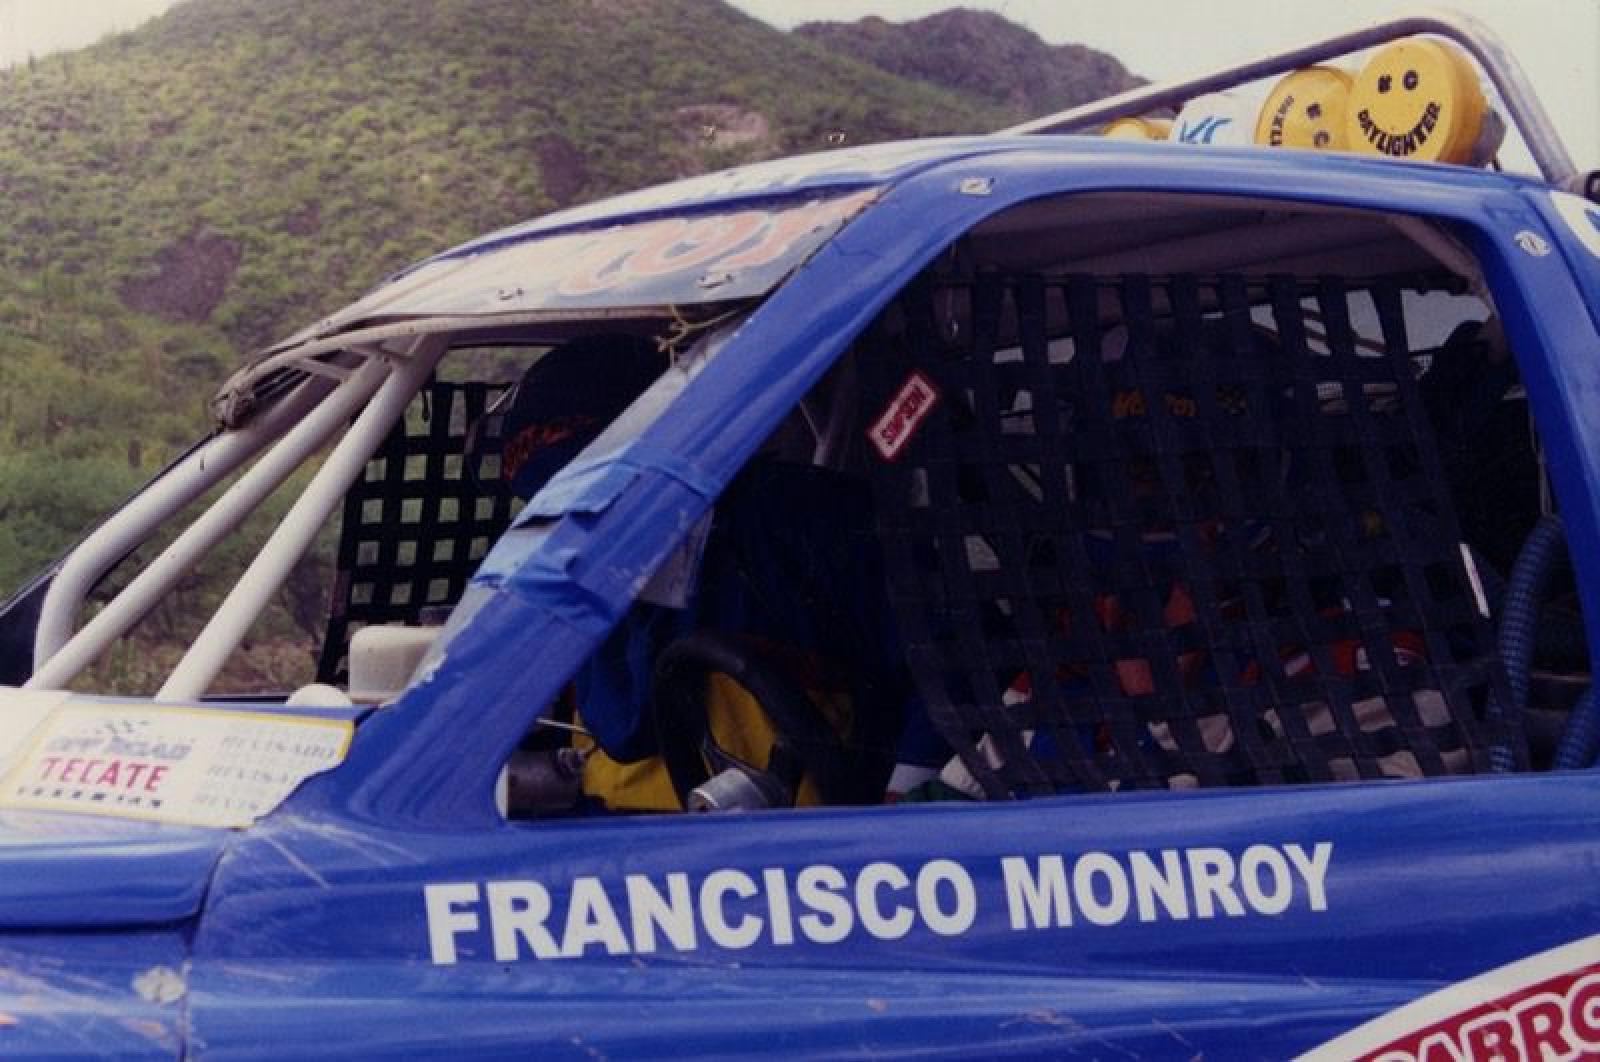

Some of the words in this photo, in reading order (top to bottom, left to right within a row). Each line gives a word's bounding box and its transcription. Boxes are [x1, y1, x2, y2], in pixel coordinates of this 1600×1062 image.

[1357, 101, 1441, 156] DAYLIGHTER
[41, 757, 169, 792] TECATE
[424, 859, 977, 964] FRANCISCO
[1002, 842, 1334, 931] MONROY
